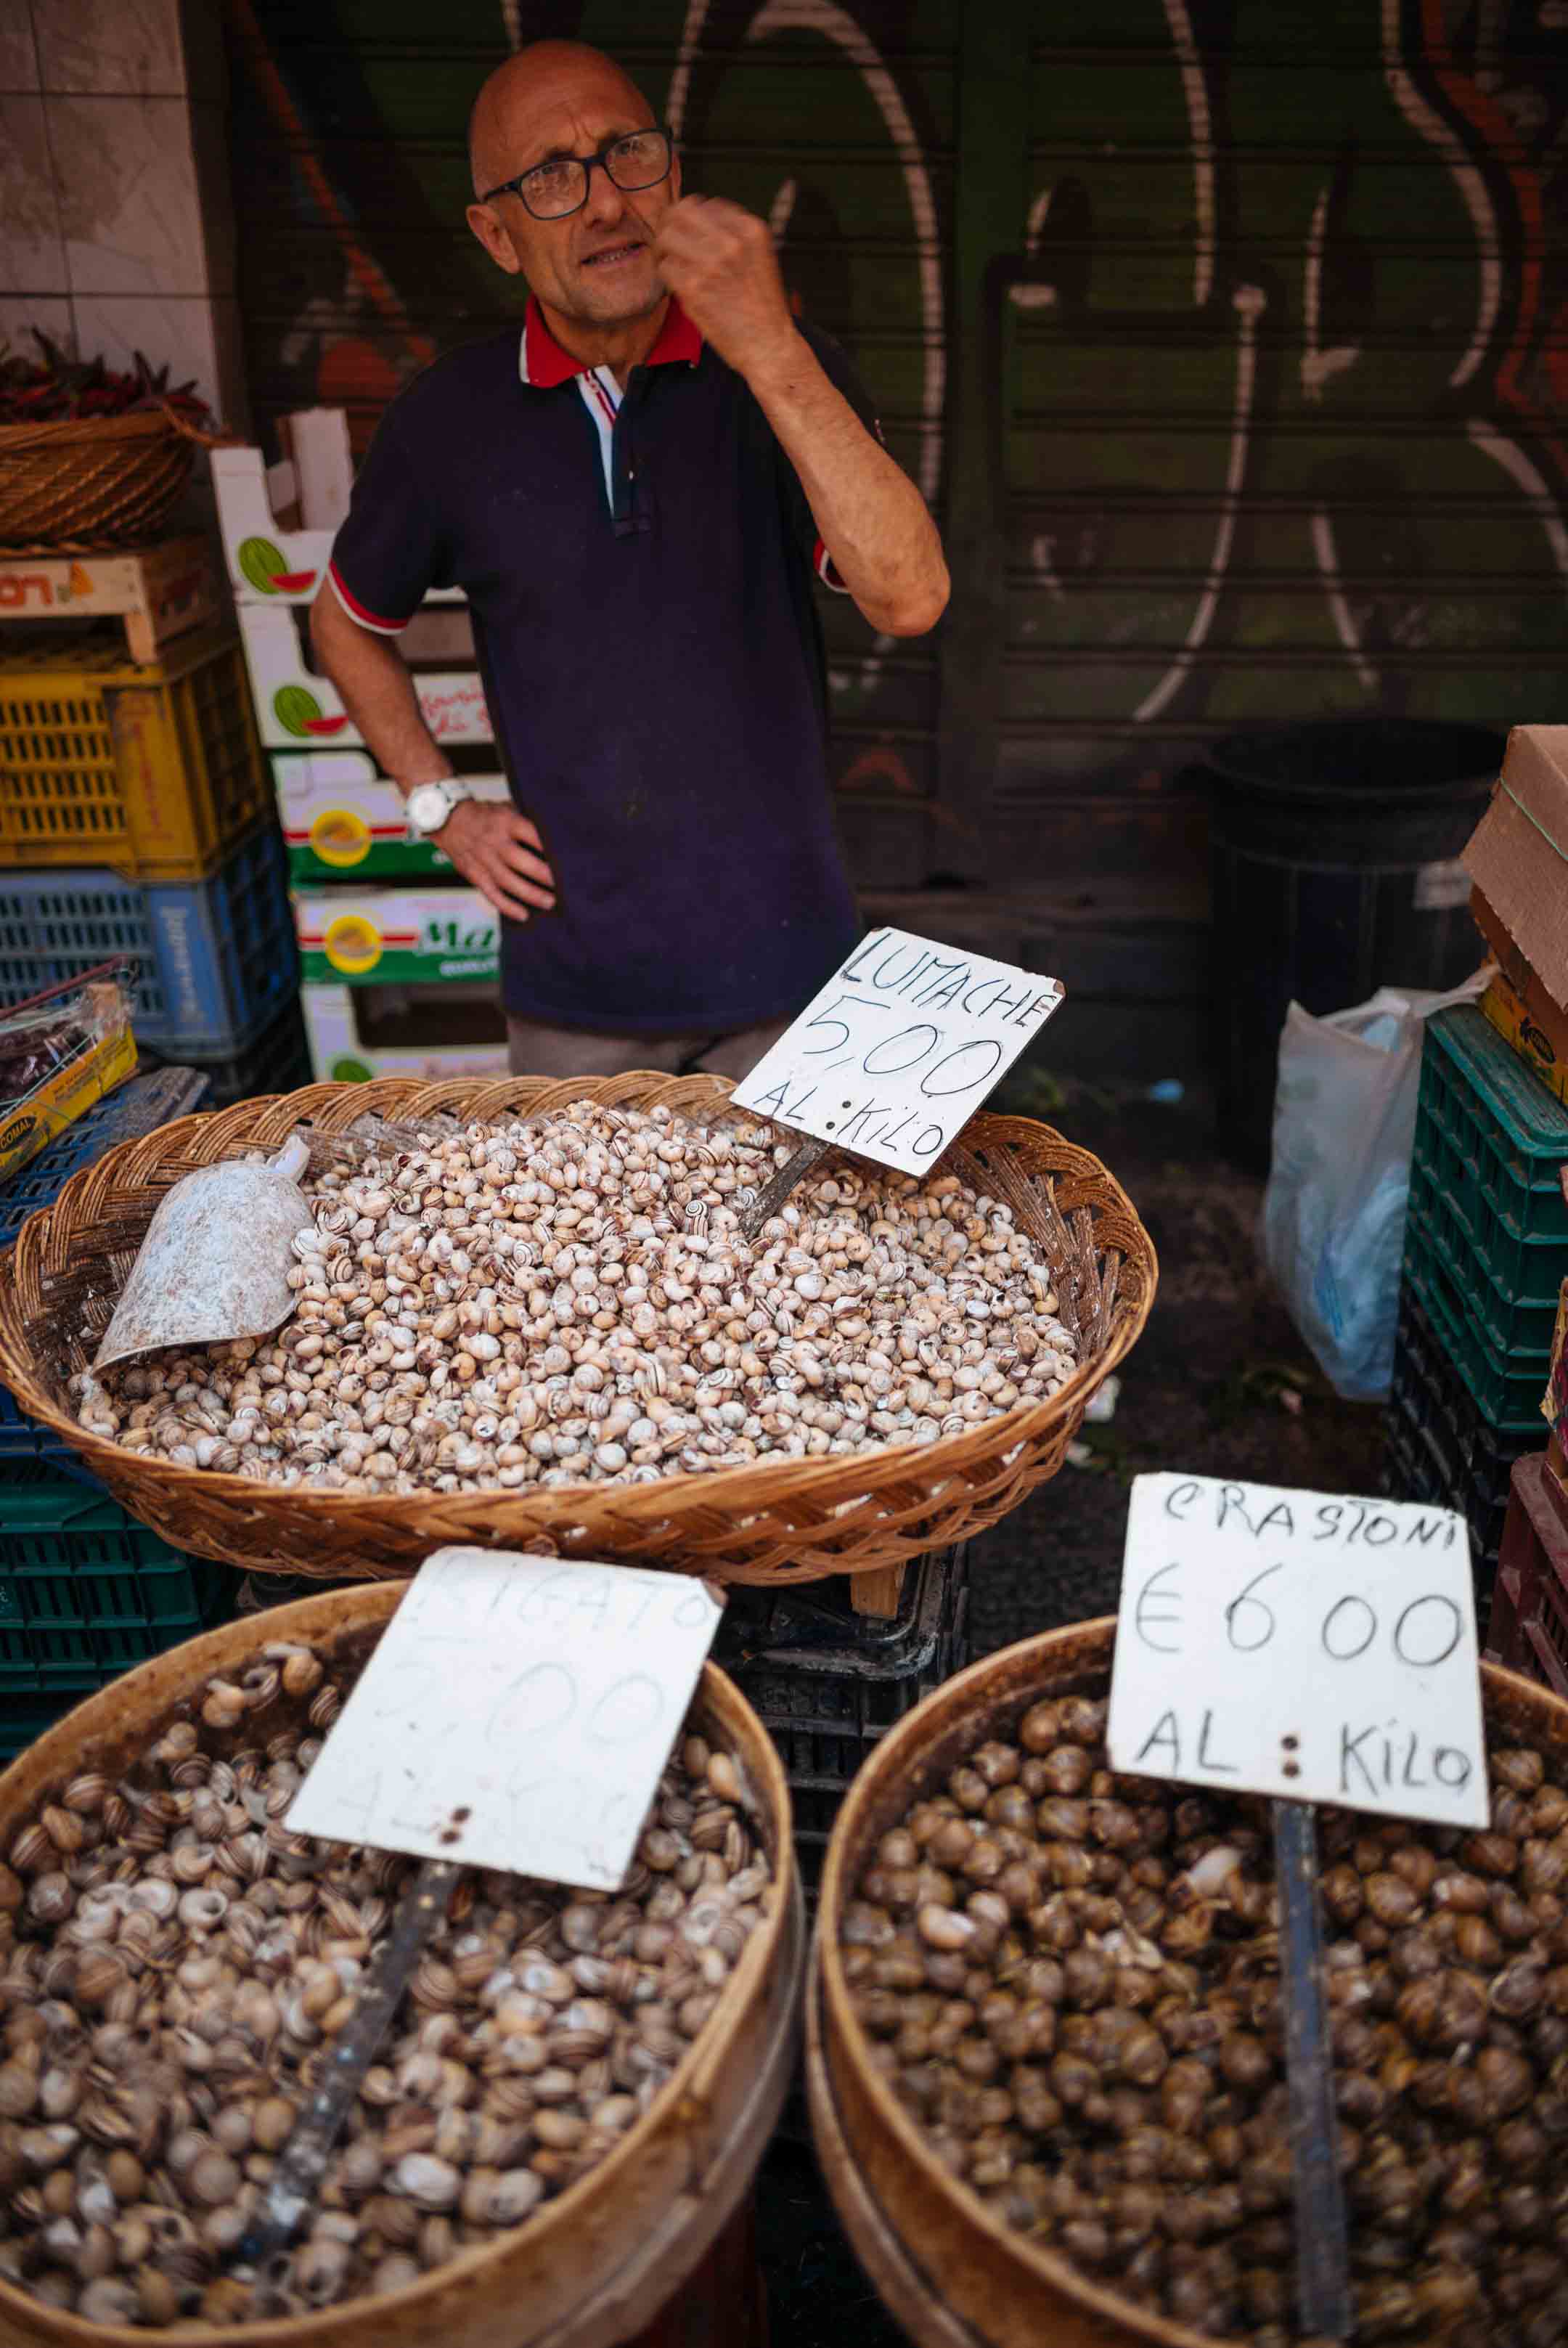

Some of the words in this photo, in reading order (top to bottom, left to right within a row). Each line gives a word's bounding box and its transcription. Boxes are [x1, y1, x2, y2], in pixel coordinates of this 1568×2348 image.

[841, 932, 1058, 1027] LUMACHE
[753, 1080, 818, 1120] AL
[1134, 1708, 1238, 1777] AL
